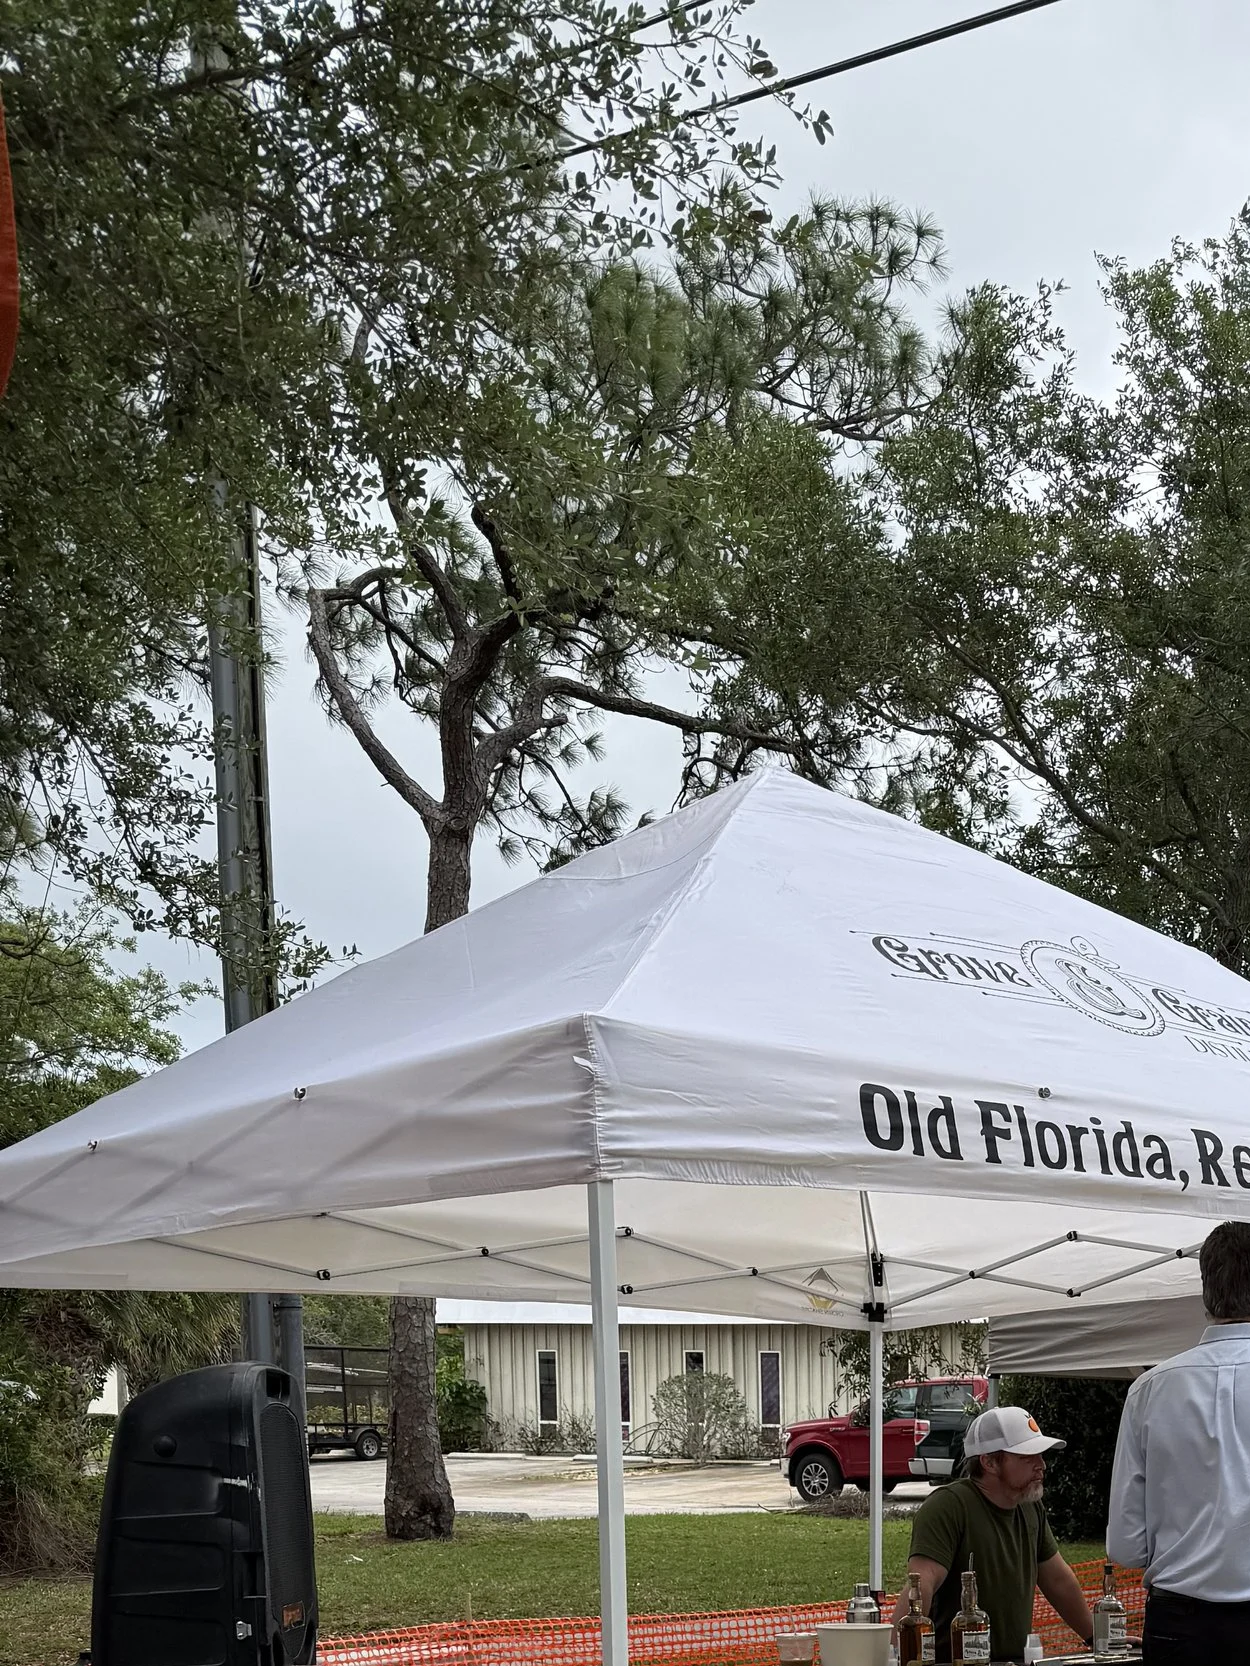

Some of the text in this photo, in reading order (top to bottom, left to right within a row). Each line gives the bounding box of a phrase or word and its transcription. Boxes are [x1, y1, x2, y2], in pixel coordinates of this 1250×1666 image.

[871, 936, 1034, 988] Grove
[1054, 957, 1147, 1020] &
[858, 1082, 964, 1162] Old
[975, 1100, 1189, 1191] Florida,
